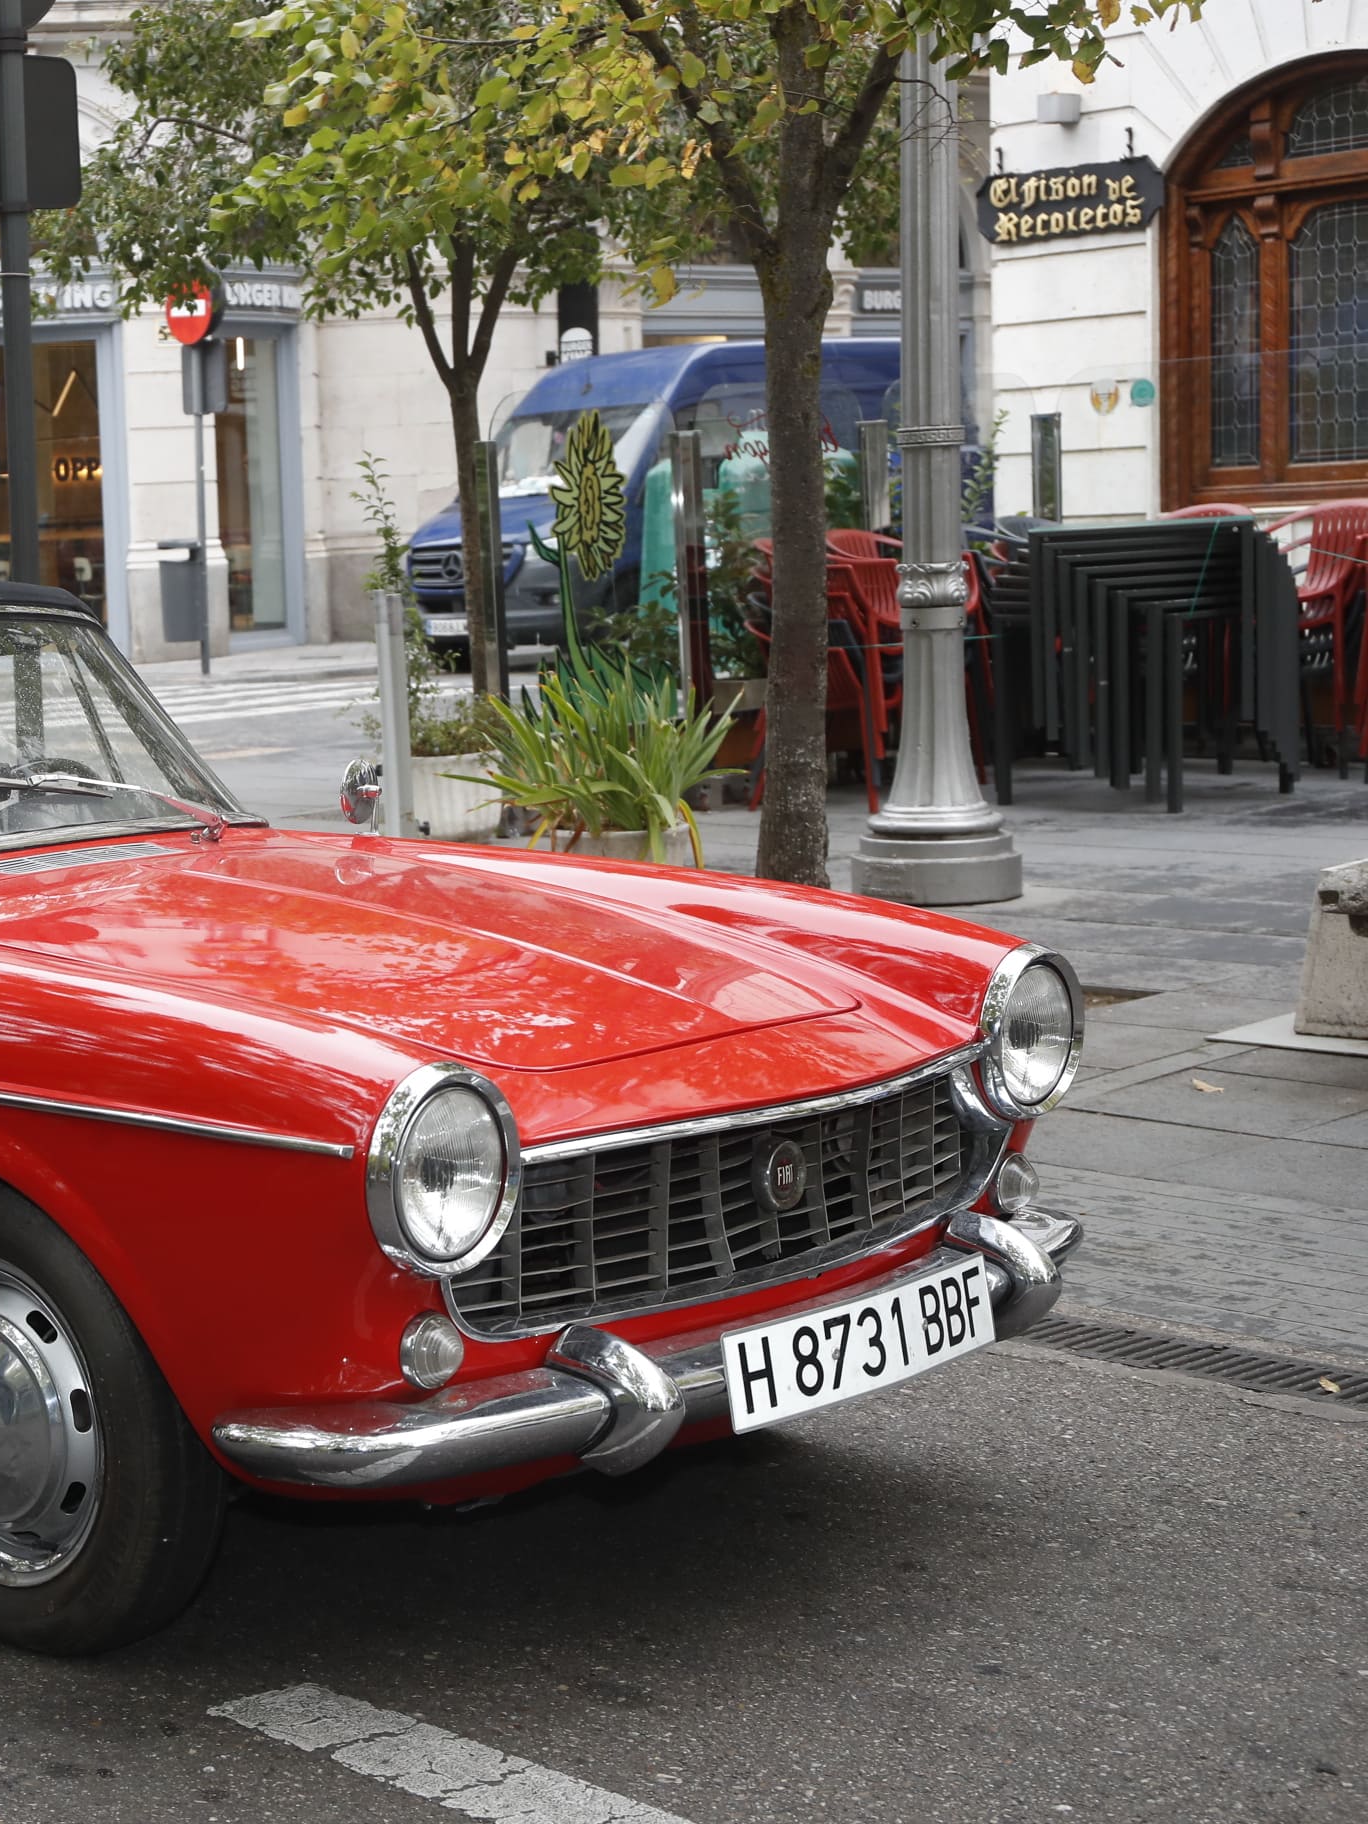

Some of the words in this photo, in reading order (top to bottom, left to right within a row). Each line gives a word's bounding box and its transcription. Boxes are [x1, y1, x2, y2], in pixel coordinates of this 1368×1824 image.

[1105, 174, 1137, 200] de
[994, 197, 1145, 241] Recoletos
[225, 281, 281, 306] URGER
[863, 289, 901, 310] BURG
[777, 1163, 793, 1187] FIAT
[737, 1336, 778, 1414] H
[792, 1296, 910, 1397] 8731
[918, 1266, 981, 1356] BBF
